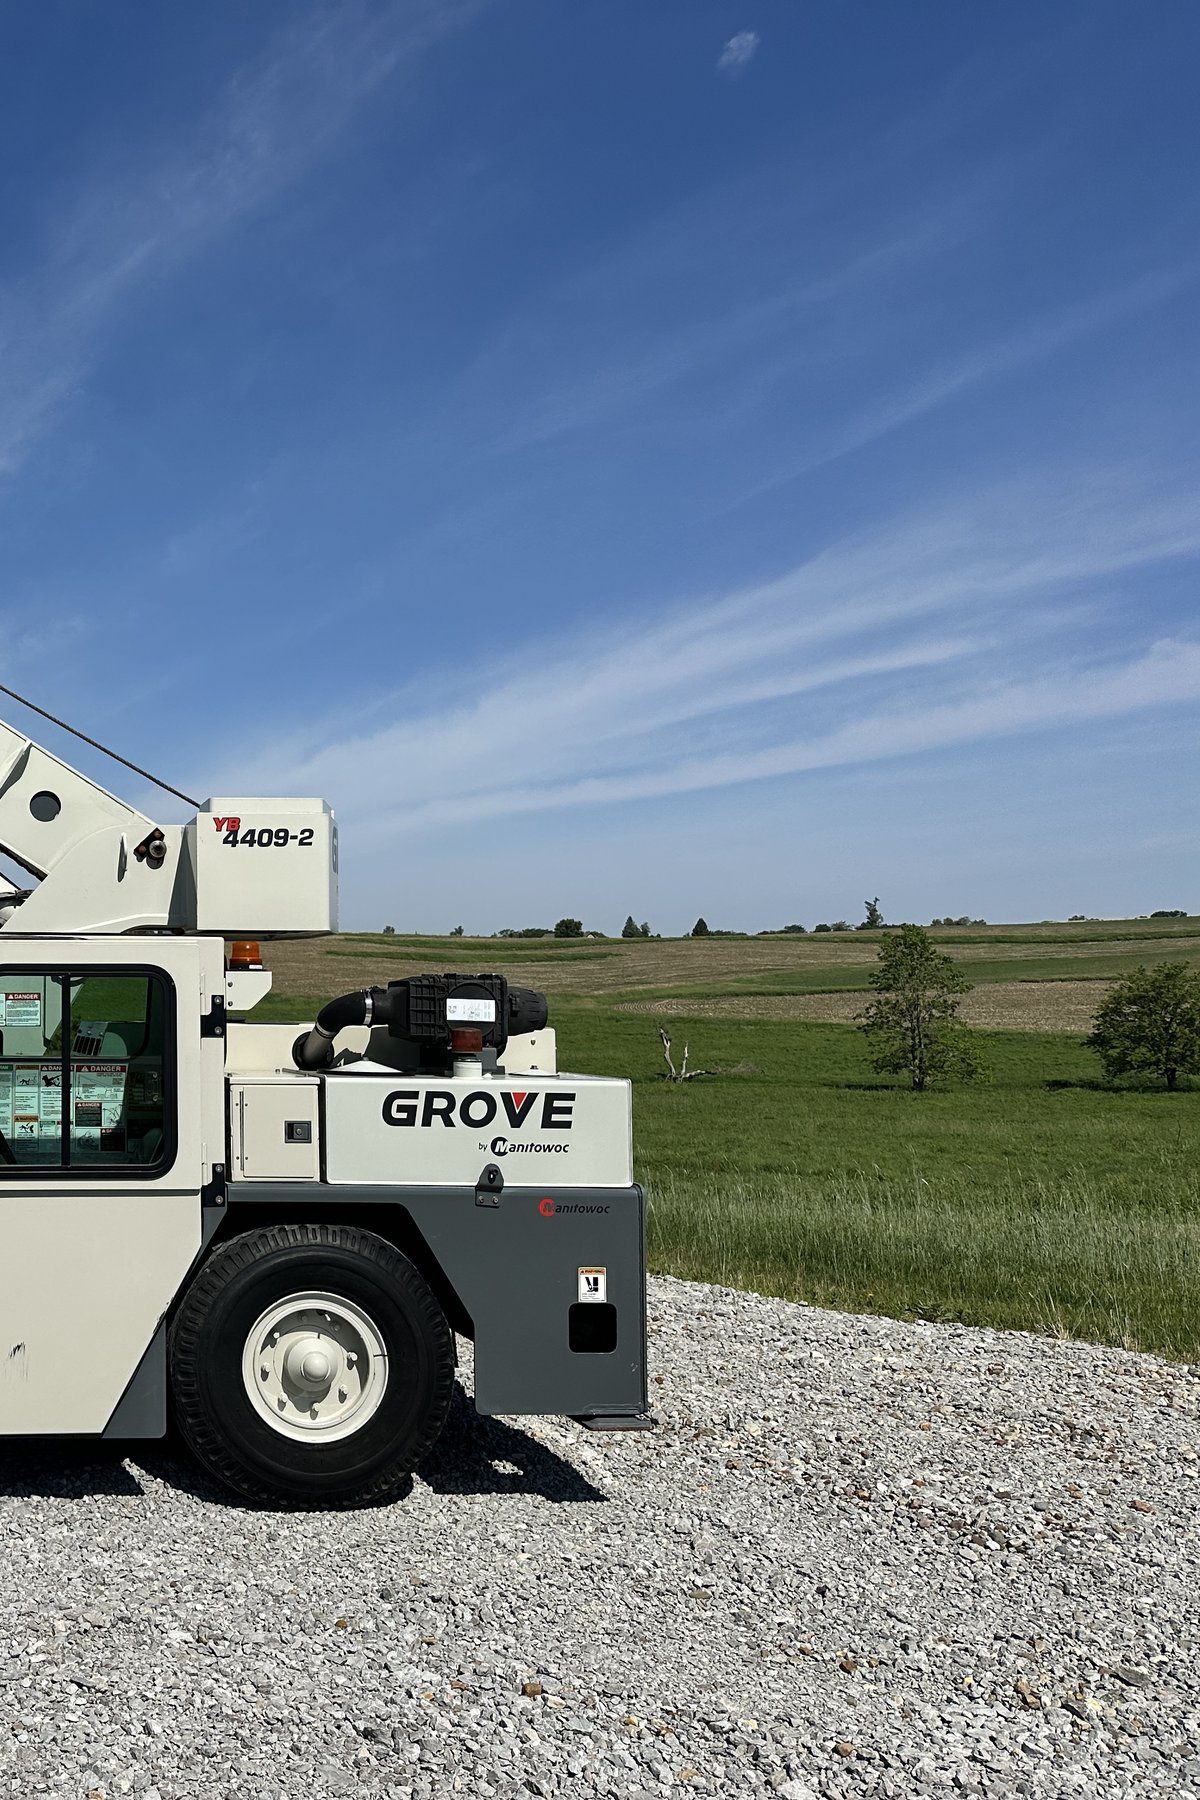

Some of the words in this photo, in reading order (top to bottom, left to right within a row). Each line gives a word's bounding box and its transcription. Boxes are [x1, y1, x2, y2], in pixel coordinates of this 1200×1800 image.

[212, 817, 241, 832] YB
[222, 828, 315, 848] 4409-2
[382, 1090, 577, 1129] GROVE
[478, 1142, 488, 1152] by
[490, 1137, 569, 1157] Manitowoc
